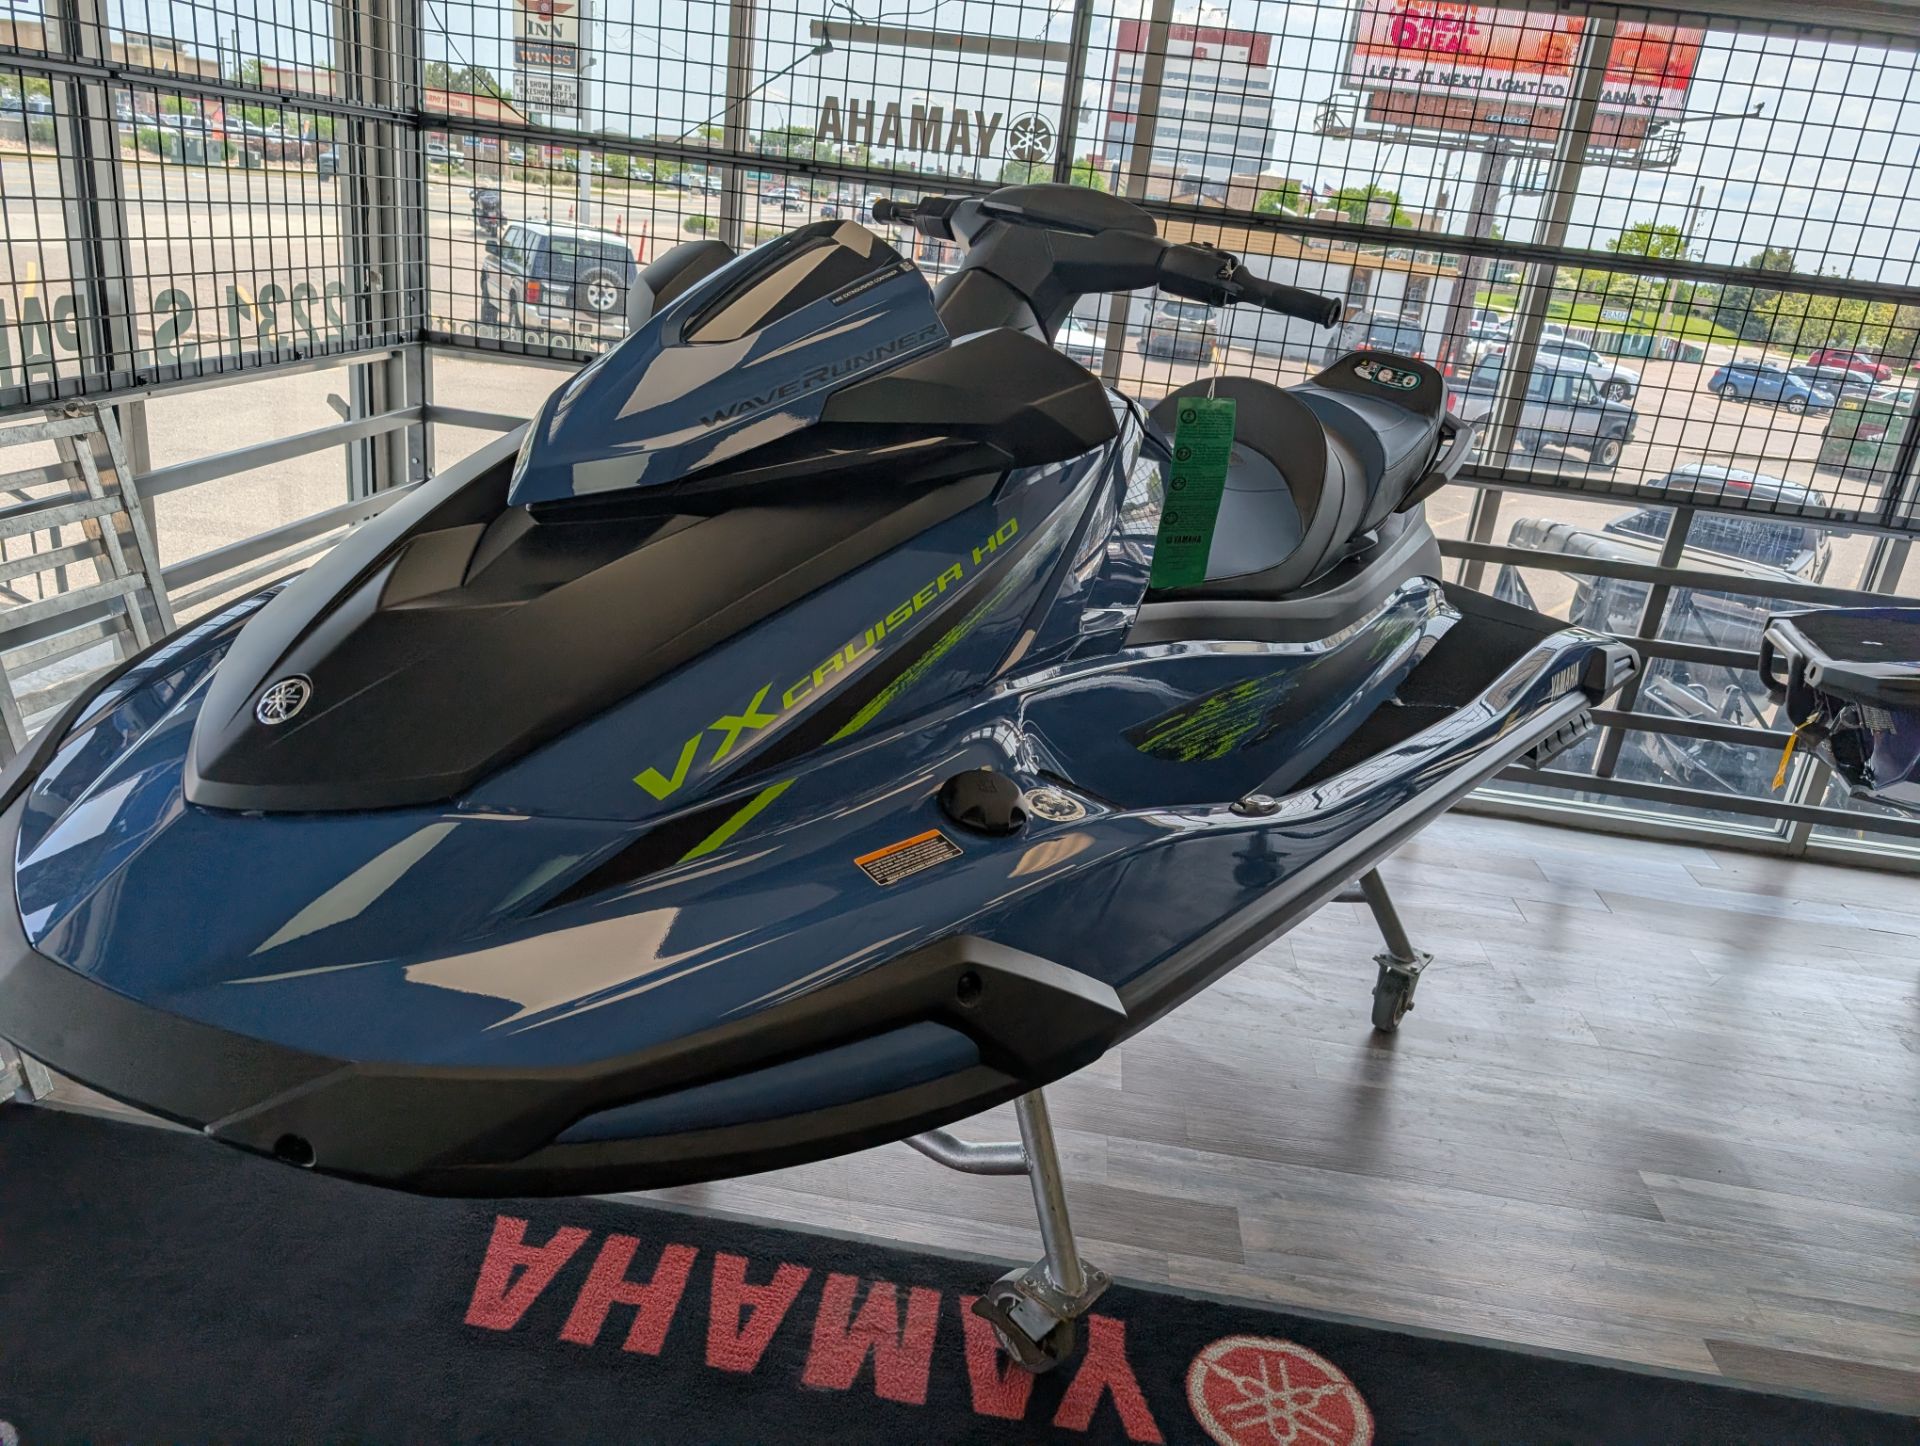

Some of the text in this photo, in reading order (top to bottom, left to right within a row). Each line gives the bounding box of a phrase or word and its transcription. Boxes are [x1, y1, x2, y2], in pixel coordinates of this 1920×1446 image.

[527, 20, 564, 38] INN
[520, 51, 572, 66] WINGS
[529, 80, 549, 89] SHOW
[564, 84, 571, 92] 21
[1370, 64, 1410, 80] LEFT
[1414, 70, 1434, 82] AT
[1439, 72, 1482, 87] NEXT
[1487, 76, 1538, 93] LIGHT
[1542, 82, 1564, 97] TO
[1642, 94, 1664, 108] ST
[633, 517, 1019, 801] VX CRUISER HO
[464, 1213, 1164, 1445] YAMAHA
